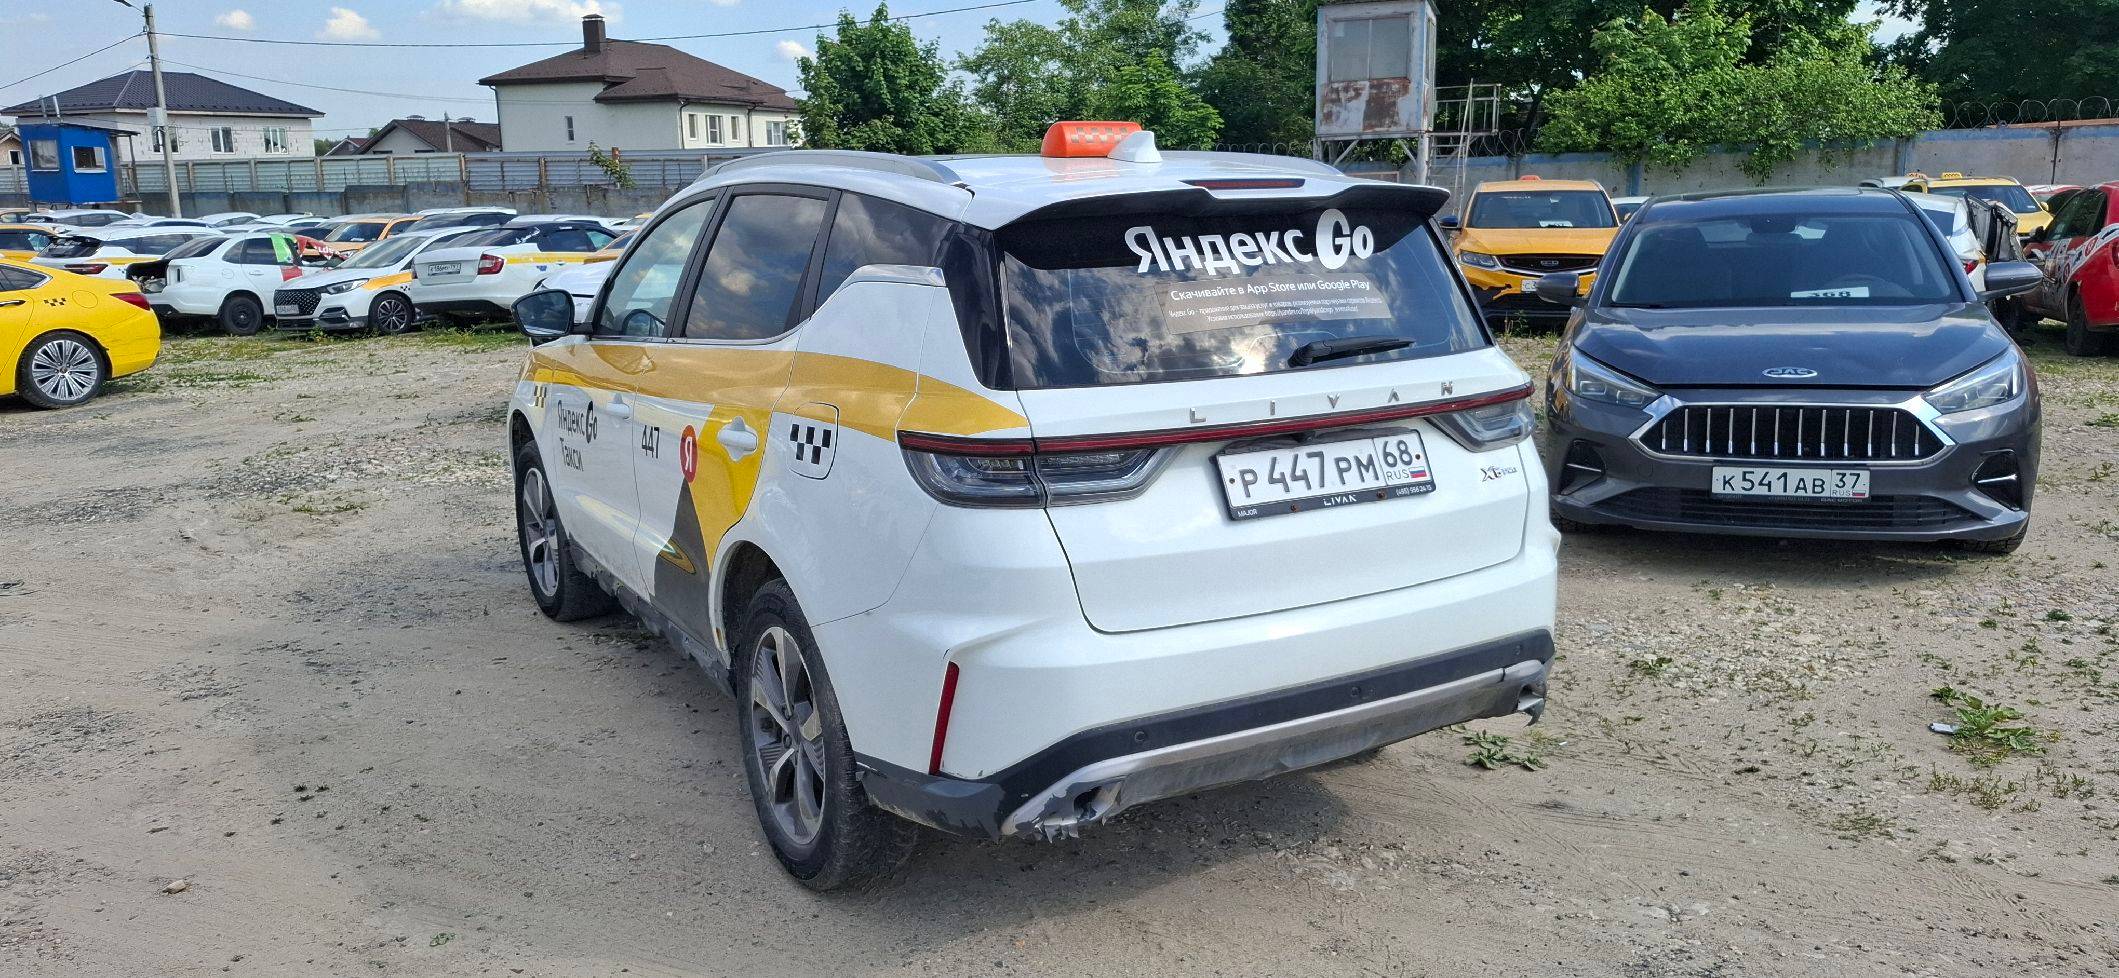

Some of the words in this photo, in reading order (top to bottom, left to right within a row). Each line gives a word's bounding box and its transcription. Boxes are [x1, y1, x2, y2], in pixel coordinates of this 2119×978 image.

[1124, 225, 1314, 276] Яндекс
[1315, 208, 1374, 270] Go
[1170, 286, 1237, 301] Скачивайте
[1238, 286, 1245, 294] в
[1247, 283, 1268, 295] App
[1268, 281, 1296, 293] Store
[1296, 281, 1316, 291] или
[1317, 280, 1350, 291] Google
[1350, 279, 1370, 291] Play
[1189, 381, 1453, 424] LIVAN
[558, 399, 585, 437] Яндекс
[585, 400, 598, 444] Go
[559, 436, 584, 472] Такси
[641, 425, 660, 459] 447
[684, 436, 693, 473] Я
[1382, 439, 1413, 468] 68
[1386, 470, 1410, 482] RUS
[1834, 472, 1861, 489] 37
[1832, 489, 1851, 497] RUS
[1237, 508, 1258, 517] MAJOR
